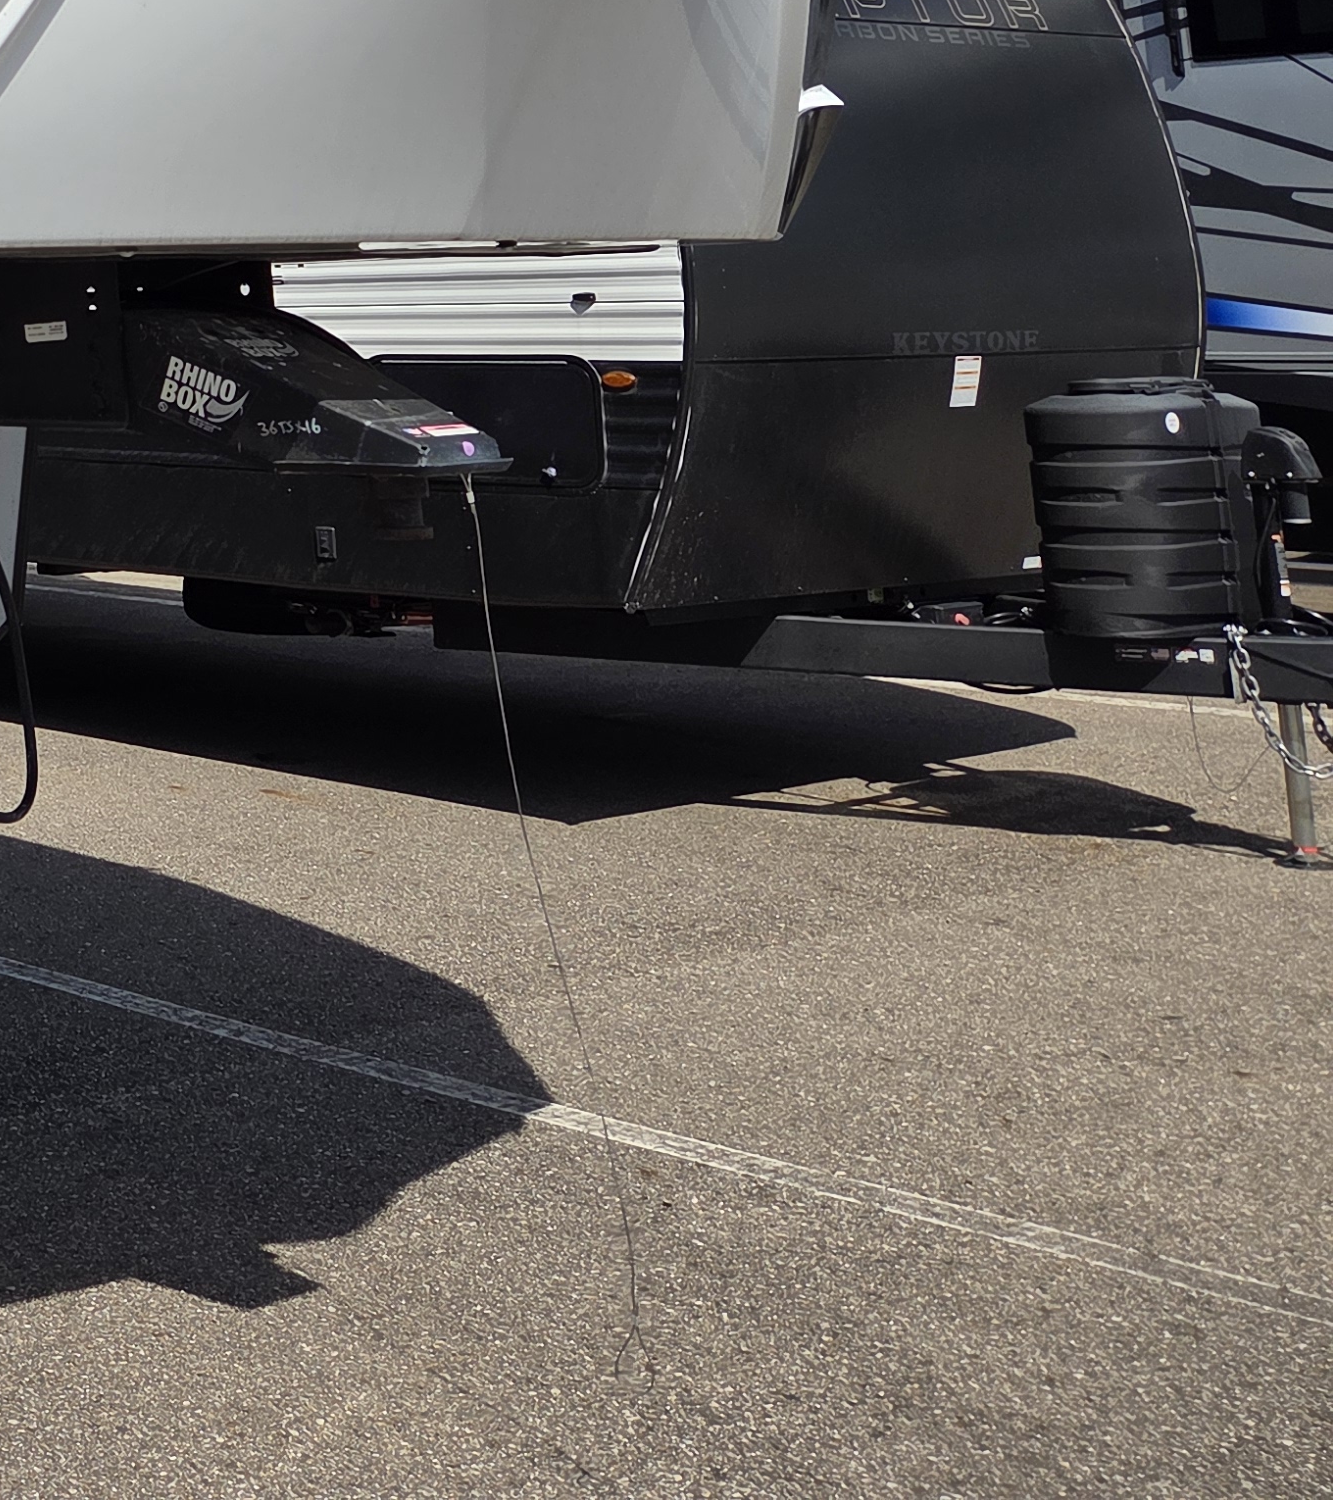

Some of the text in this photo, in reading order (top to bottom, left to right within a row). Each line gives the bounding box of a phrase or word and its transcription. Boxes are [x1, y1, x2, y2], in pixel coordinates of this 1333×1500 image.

[835, 22, 1031, 49] RBON SERIES
[892, 330, 1040, 355] KEYSTONE
[166, 355, 237, 403] RHINO
[159, 378, 211, 418] BOX
